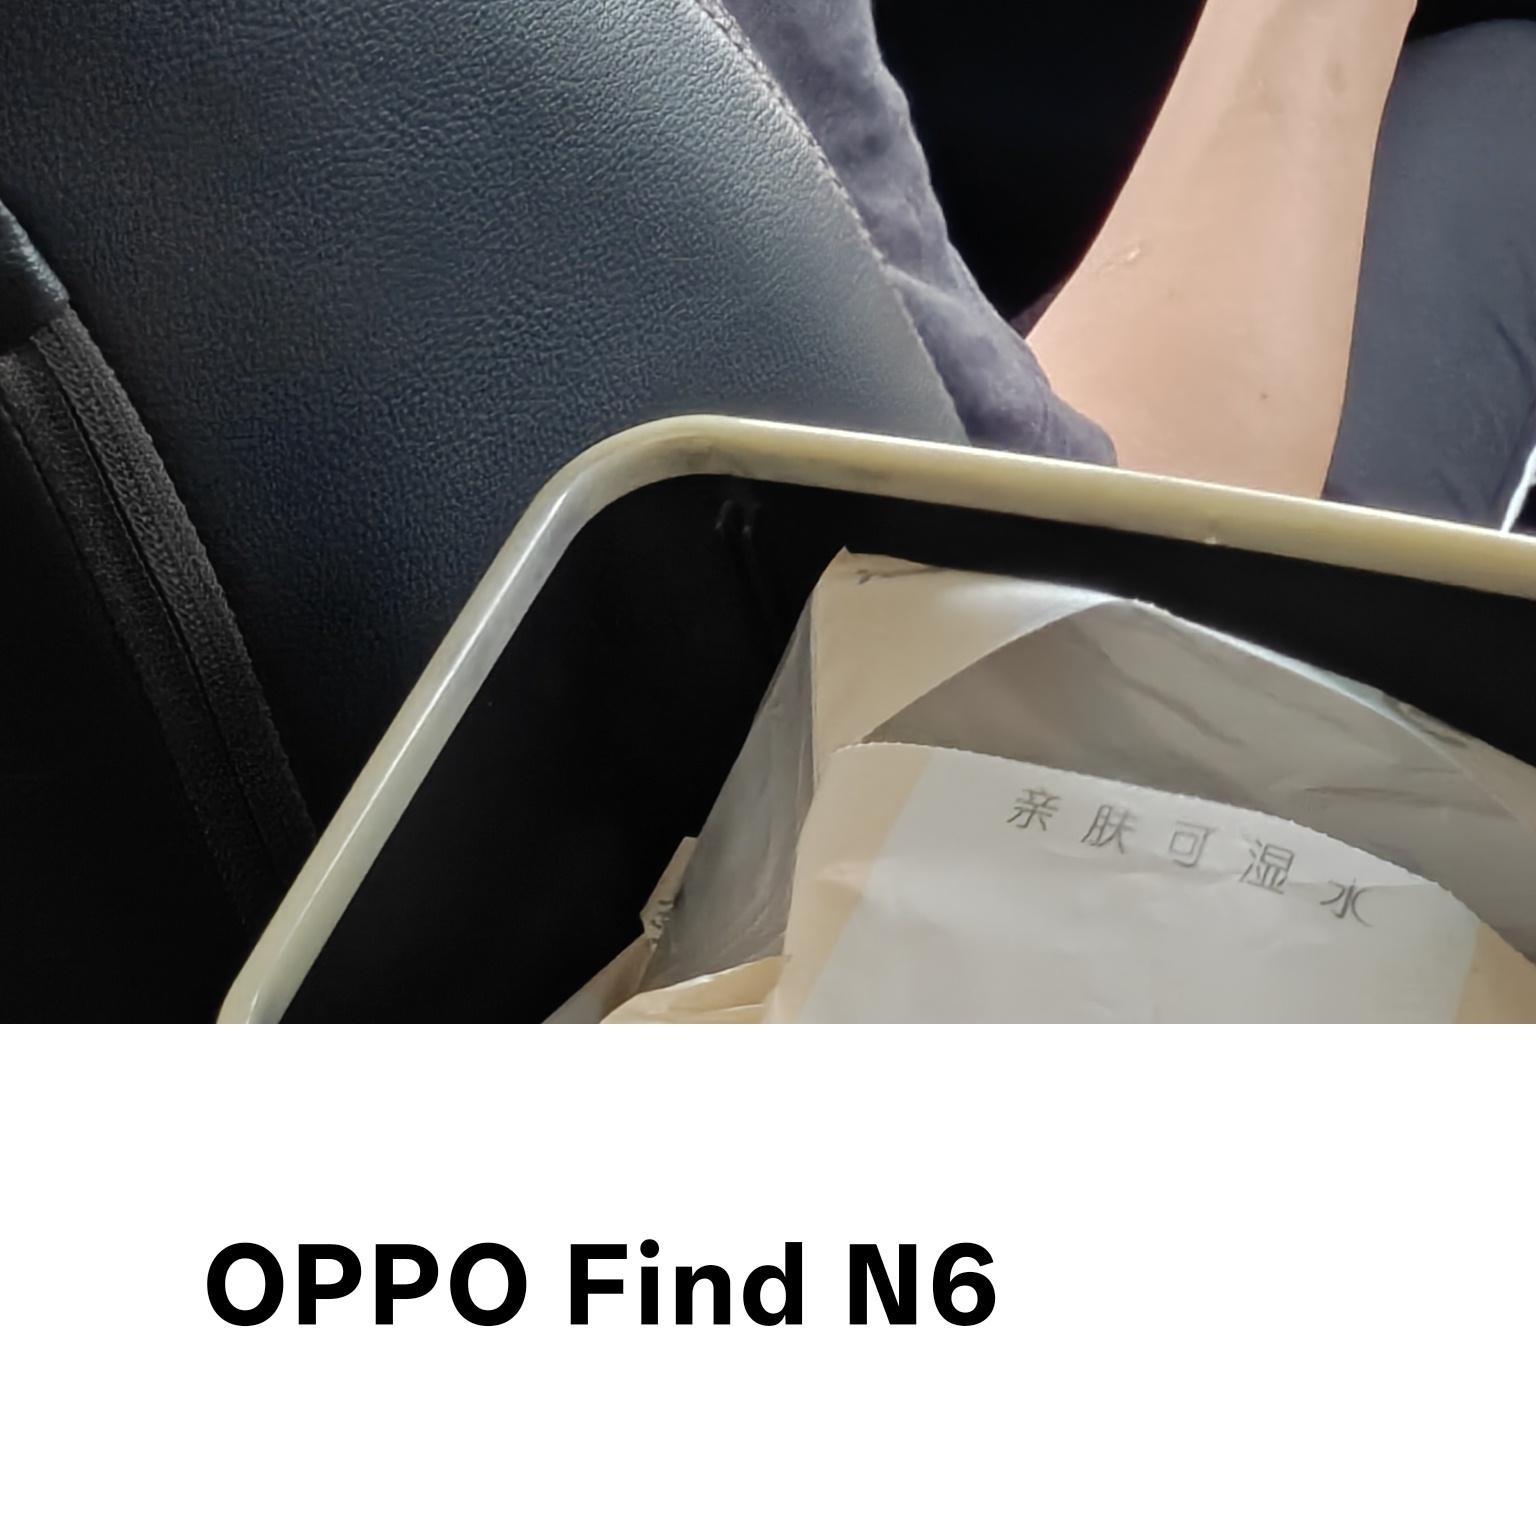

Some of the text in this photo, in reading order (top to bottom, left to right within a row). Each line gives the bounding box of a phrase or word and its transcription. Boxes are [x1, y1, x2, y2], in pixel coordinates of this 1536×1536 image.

[1006, 786, 1376, 928] 亲肤可湿水
